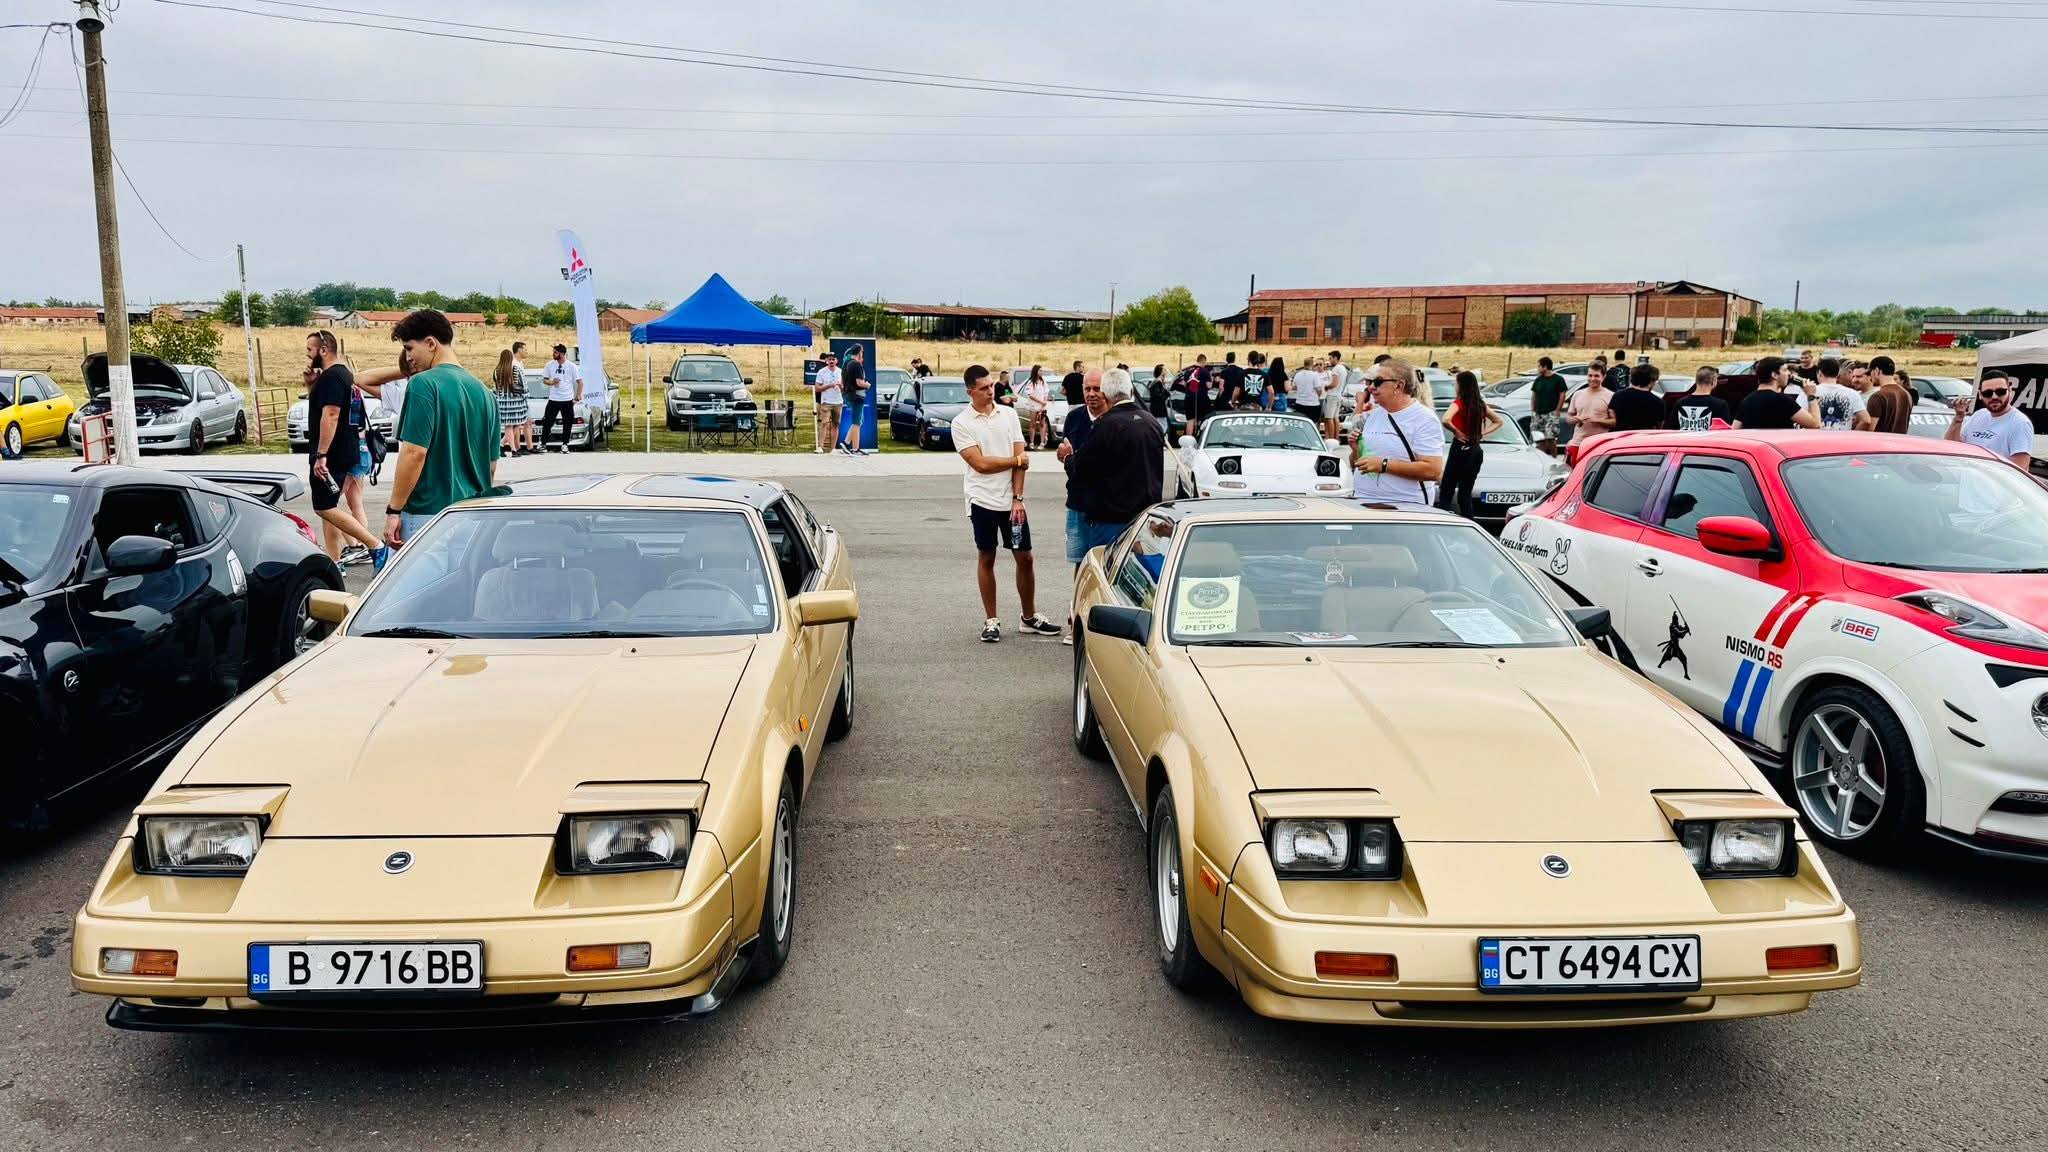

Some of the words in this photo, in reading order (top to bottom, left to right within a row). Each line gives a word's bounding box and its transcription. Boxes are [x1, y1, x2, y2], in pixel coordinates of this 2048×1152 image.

[1488, 493, 1499, 502] CB
[1501, 494, 1520, 503] 2726
[1501, 538, 1523, 551] CHELIN
[1845, 622, 1875, 637] BRE
[1725, 635, 1765, 662] NISMO
[1767, 651, 1783, 669] RS
[252, 974, 268, 984] BG
[288, 951, 311, 985] B
[331, 950, 418, 985] 9716
[427, 950, 474, 984] BB
[1484, 968, 1499, 979] BG
[1505, 945, 1550, 980] CT
[1559, 945, 1641, 980] 6494
[1649, 943, 1692, 978] CX
